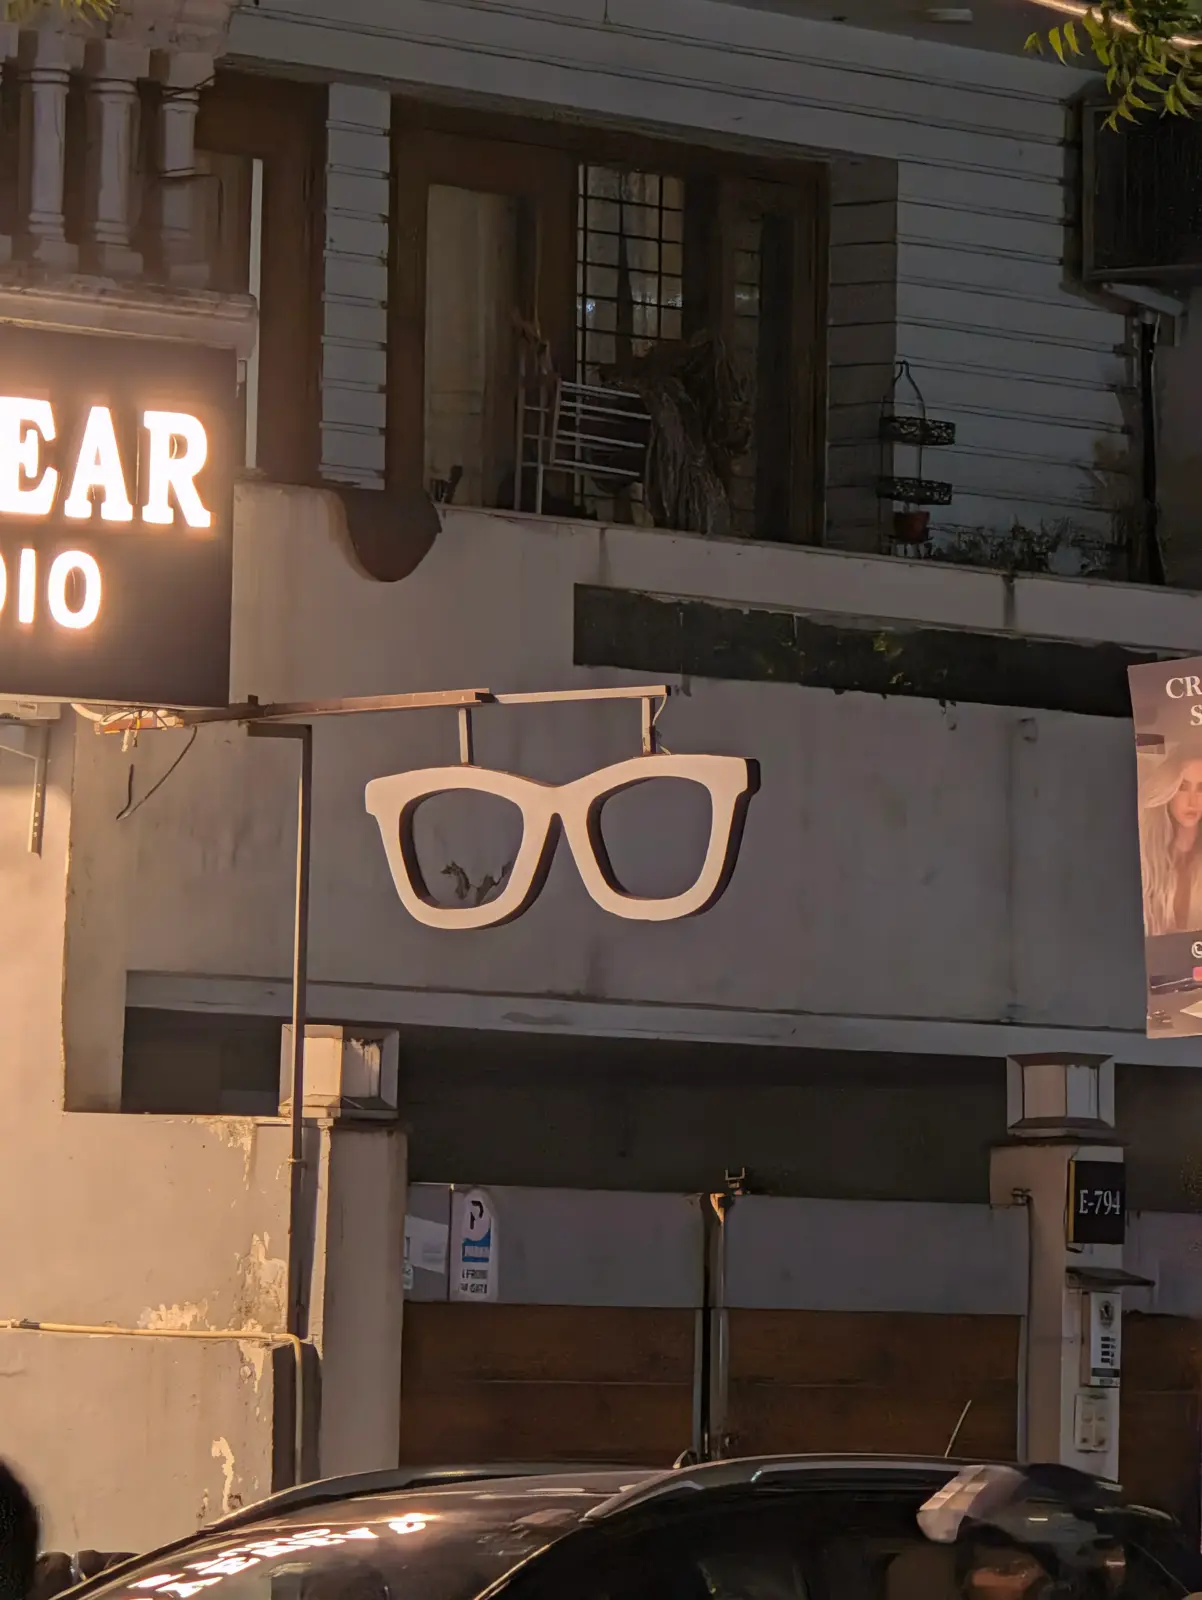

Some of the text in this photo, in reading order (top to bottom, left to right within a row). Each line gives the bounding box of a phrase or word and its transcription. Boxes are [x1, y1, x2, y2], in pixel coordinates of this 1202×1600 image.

[0, 547, 102, 629] IO
[1165, 675, 1202, 699] CR
[1079, 1189, 1121, 1215] E-794
